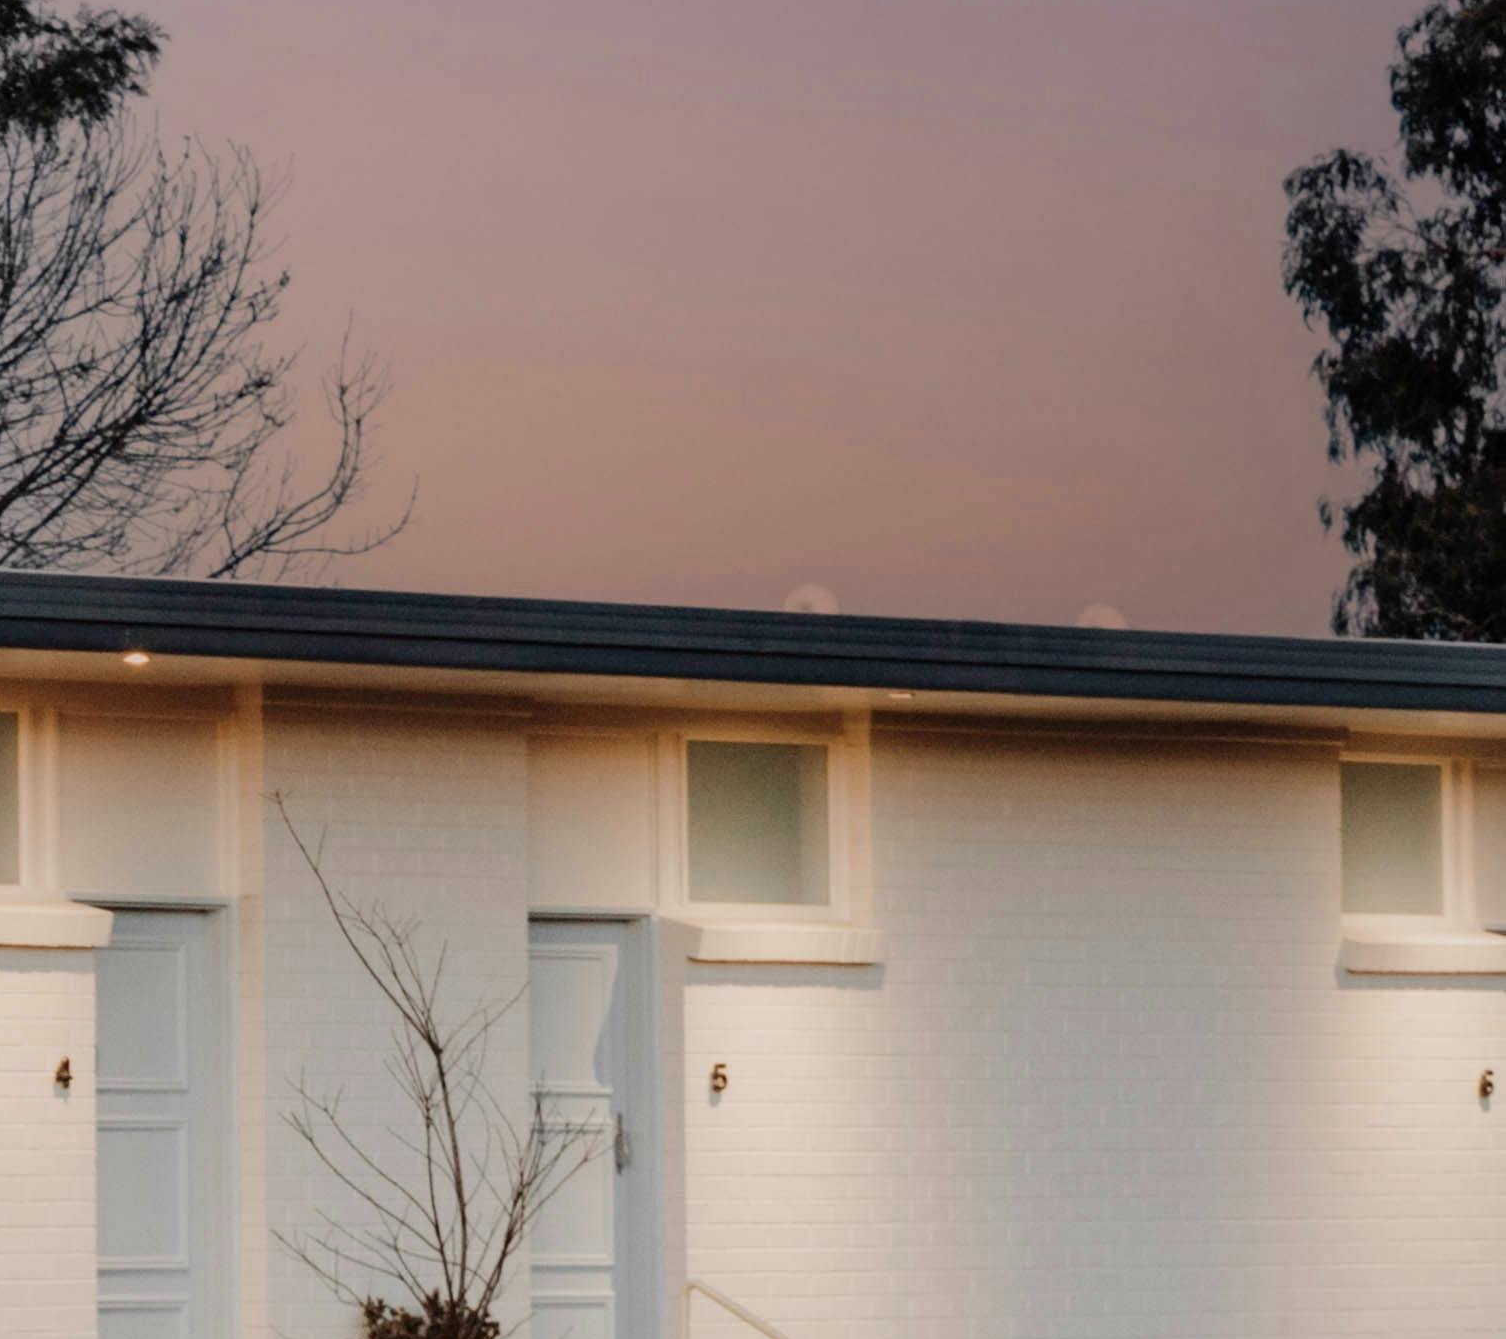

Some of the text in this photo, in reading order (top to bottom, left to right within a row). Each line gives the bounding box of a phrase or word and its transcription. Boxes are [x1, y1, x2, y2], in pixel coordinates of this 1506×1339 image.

[55, 1056, 73, 1090] 4
[711, 1063, 728, 1093] 5
[1479, 1069, 1494, 1099] 6
